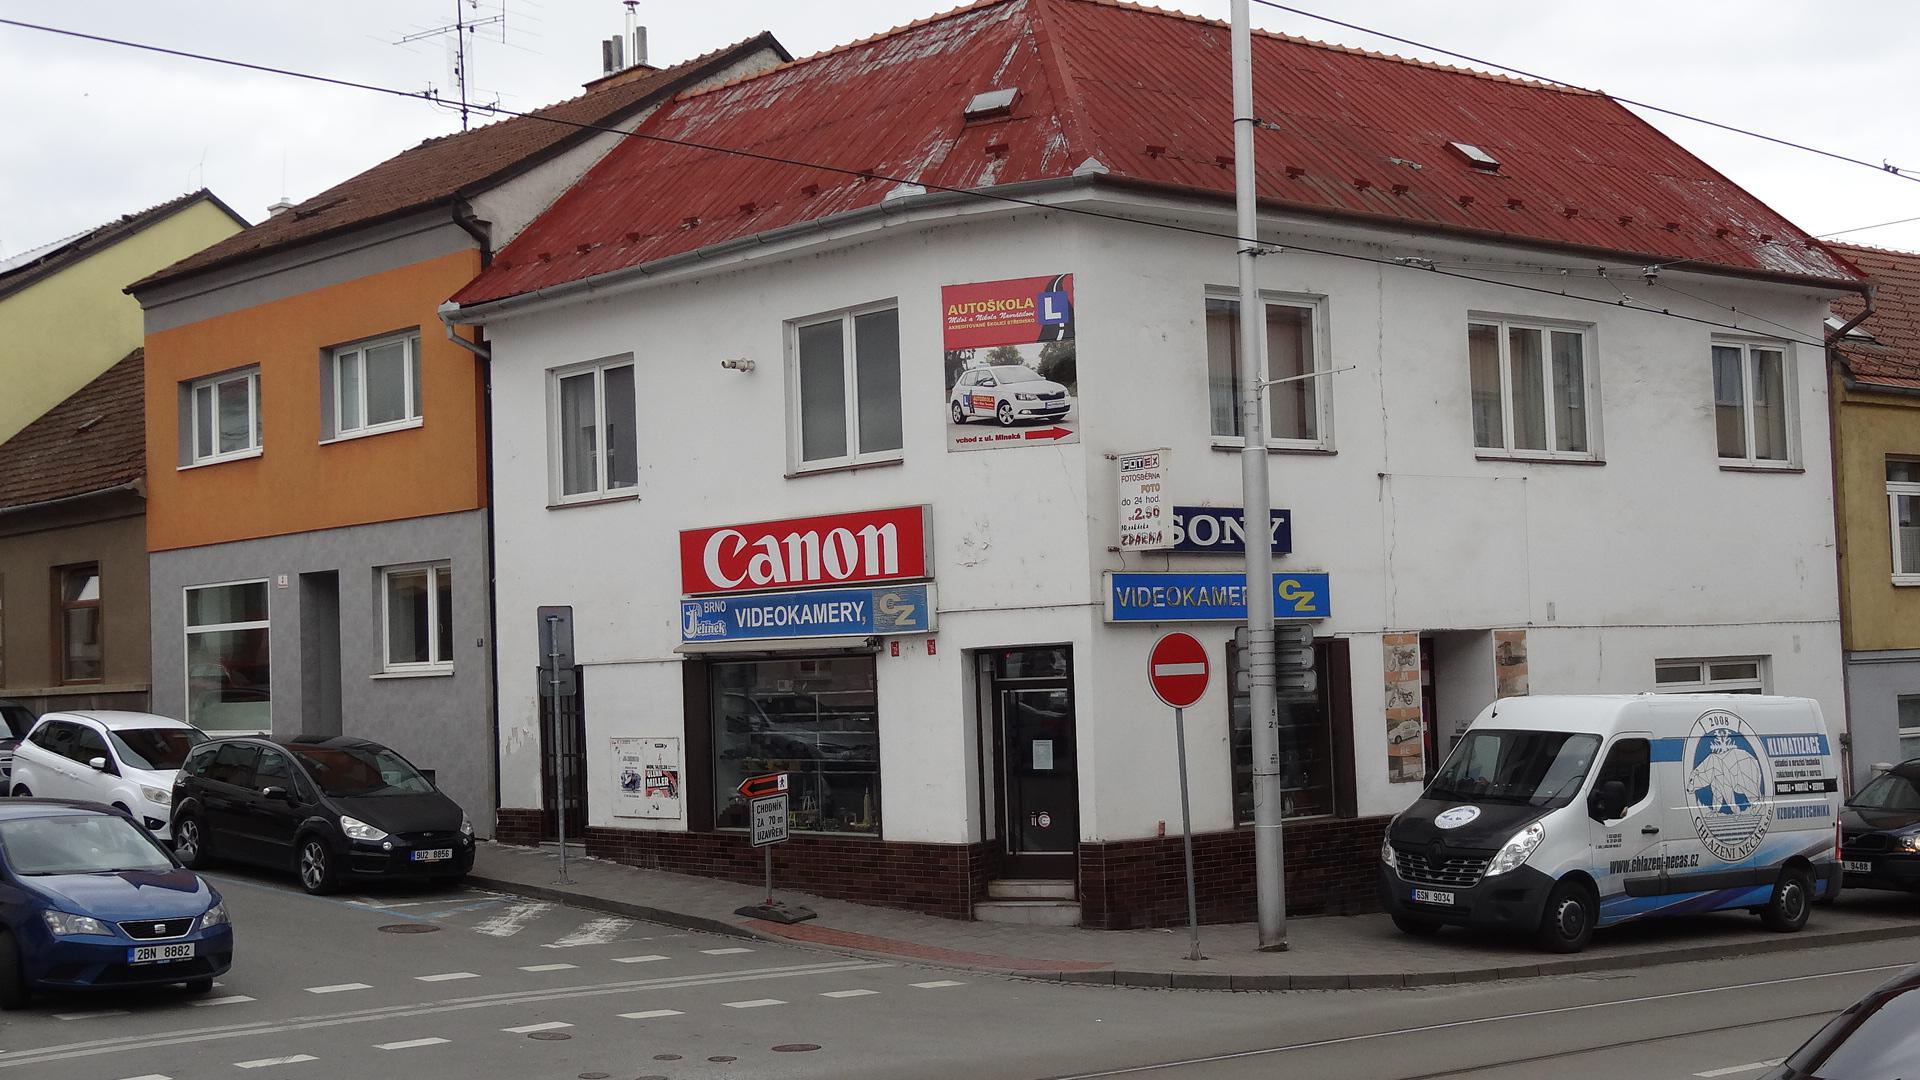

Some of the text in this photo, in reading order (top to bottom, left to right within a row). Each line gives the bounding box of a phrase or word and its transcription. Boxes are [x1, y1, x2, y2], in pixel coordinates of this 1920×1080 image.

[948, 297, 1034, 316] AUTOŠKOLA
[1044, 297, 1061, 320] L
[995, 433, 1021, 441] Minská
[1121, 454, 1159, 472] FOTEX
[1141, 483, 1160, 494] FOTO
[1121, 495, 1160, 506] do 24 hod.
[1121, 531, 1162, 546] ZDARMA
[703, 522, 899, 588] Canon
[704, 601, 726, 613] BRNO
[1709, 715, 1729, 727] 2008
[1767, 736, 1821, 756] KLIMATIZACE
[647, 777, 669, 787] MILLER
[756, 800, 783, 814] CHODNÍK
[1776, 804, 1830, 820] VZDUCHOTECHNIKA
[757, 815, 783, 828] ZA 70 m
[757, 827, 784, 841] UZAVŘEN
[1694, 816, 1736, 860] CHLAZENÍ
[1739, 825, 1766, 857] NEČAS
[416, 851, 429, 859] 9U2
[1609, 853, 1700, 875] www.chlazeni-necas.cz
[1416, 889, 1451, 902] 6SN 9034
[137, 948, 157, 960] 2BN
[164, 945, 190, 958] 8882
